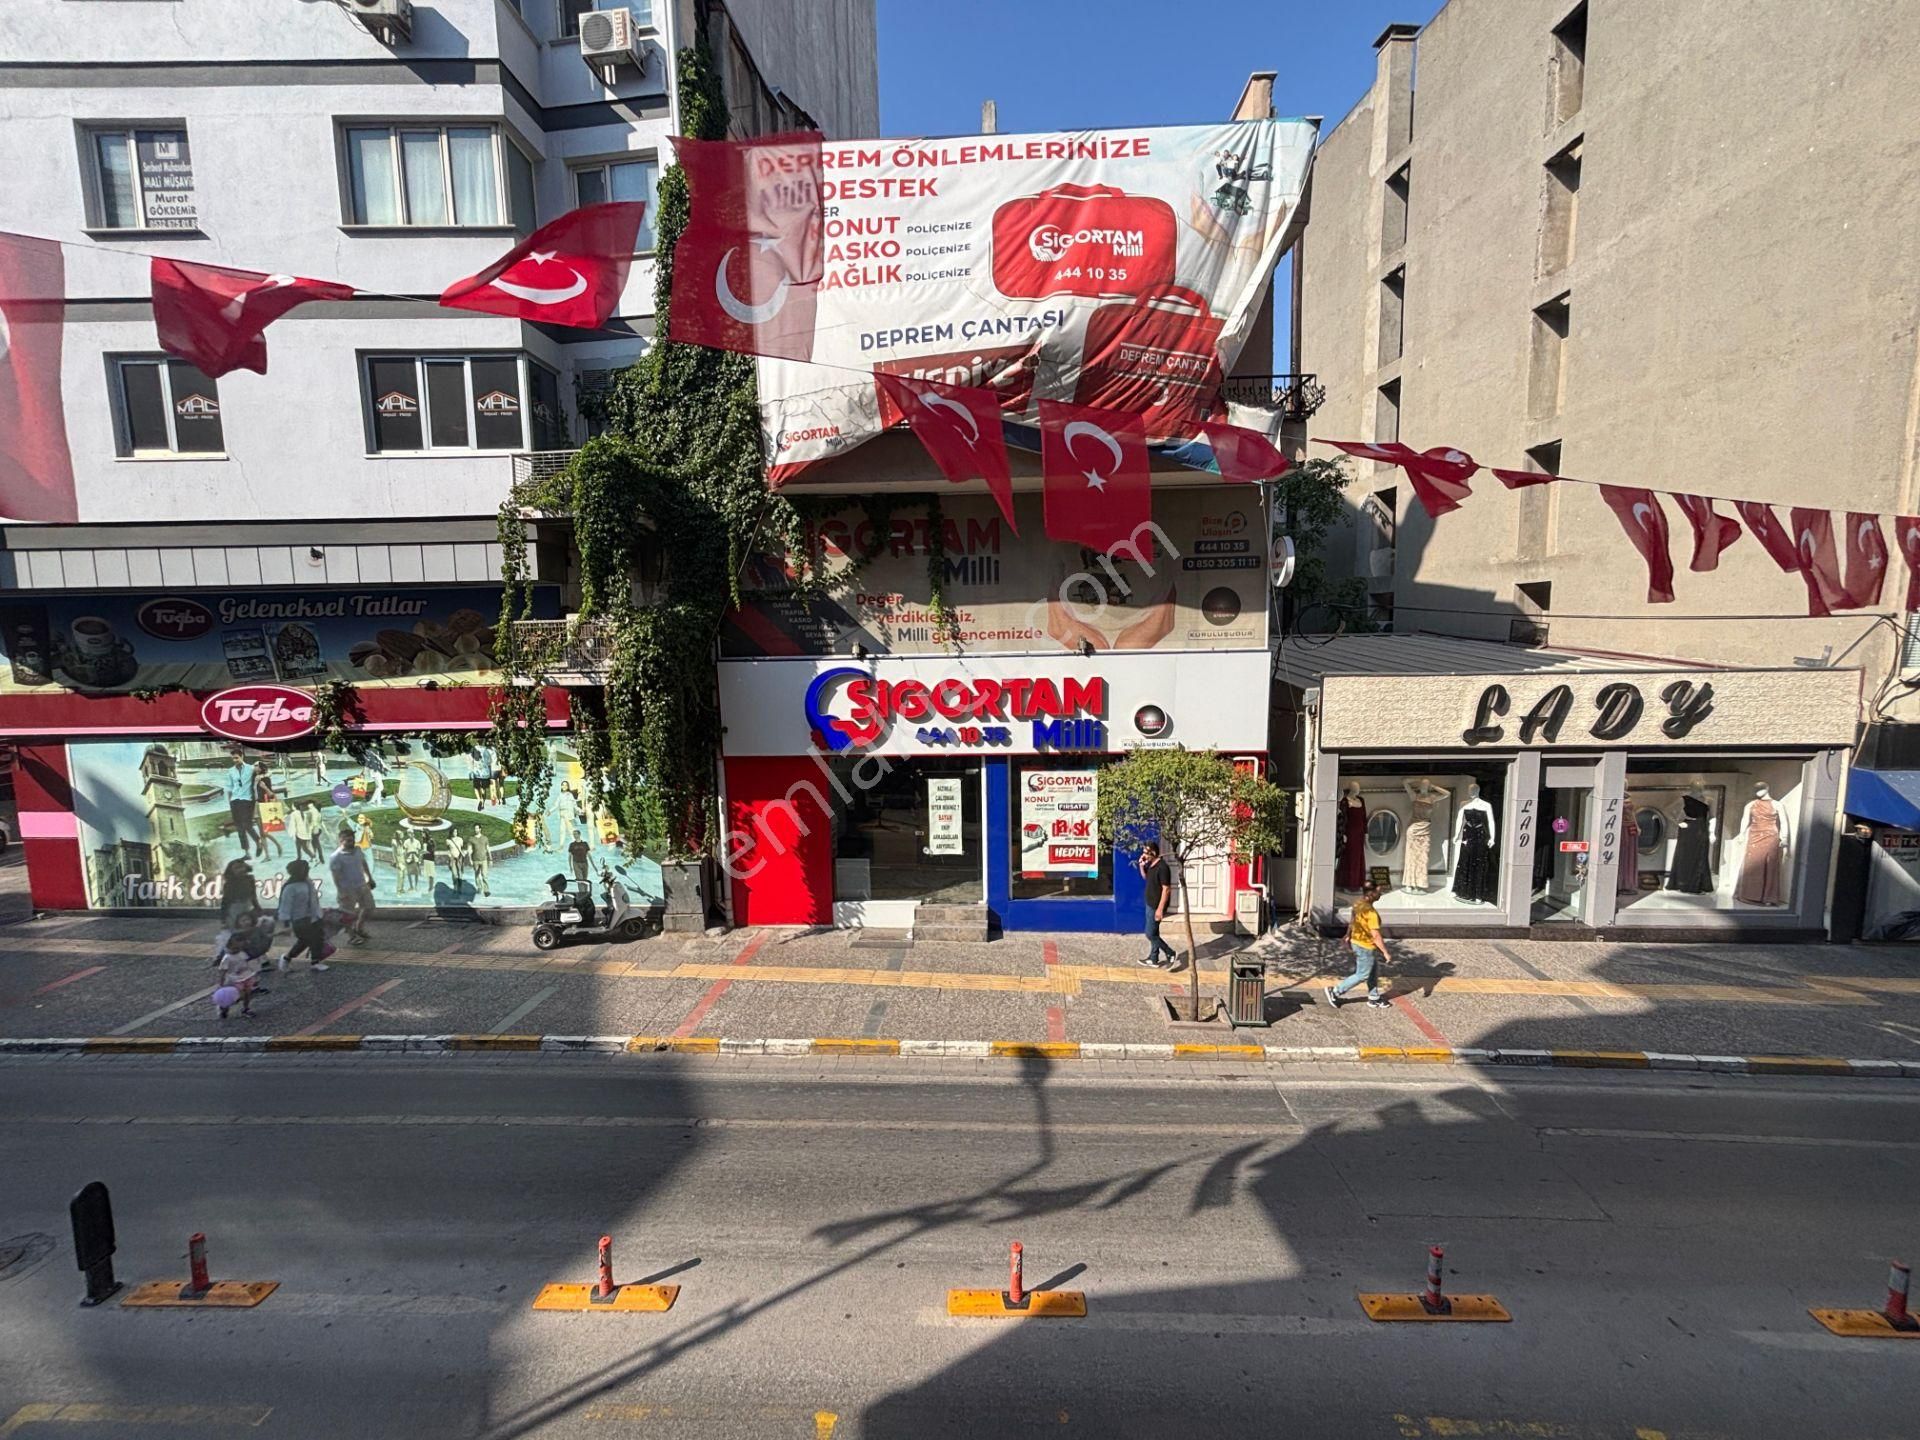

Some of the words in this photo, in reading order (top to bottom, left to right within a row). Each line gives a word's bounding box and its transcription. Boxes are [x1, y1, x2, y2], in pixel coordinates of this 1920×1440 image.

[891, 137, 1151, 168] ÖNLEMLERİNİZE
[819, 177, 939, 201] DESTEK
[155, 194, 188, 203] Murat
[815, 207, 840, 218] ER
[906, 221, 973, 234] POLİÇENİZE
[816, 239, 901, 263] ASKO
[905, 243, 972, 257] POLİÇENİZE
[1113, 244, 1144, 257] Milli
[905, 267, 972, 281] POLİÇENİZE
[1054, 266, 1082, 281] 444
[1087, 268, 1104, 280] 10
[1108, 269, 1128, 281] 35
[860, 323, 954, 351] DEPREM
[961, 309, 1064, 341] ÇANTASI
[1120, 349, 1164, 366] DEPREM
[1200, 542, 1218, 551] 444
[1221, 542, 1230, 550] 10
[1233, 541, 1245, 550] 35
[941, 556, 1000, 586] Milli
[1187, 560, 1194, 568] 0
[1217, 559, 1236, 568] 305
[1238, 558, 1246, 567] 11
[1248, 558, 1256, 567] 11
[856, 593, 903, 607] Değer
[218, 597, 345, 624] Geleneksel
[349, 594, 428, 617] Tatlar
[898, 627, 929, 642] Milli
[1462, 680, 1716, 747] LADY
[958, 726, 979, 744] 10
[982, 726, 1010, 743] 35
[1032, 719, 1103, 750] Milli
[1055, 846, 1091, 858] HEDİYE
[123, 872, 185, 901] Fark
